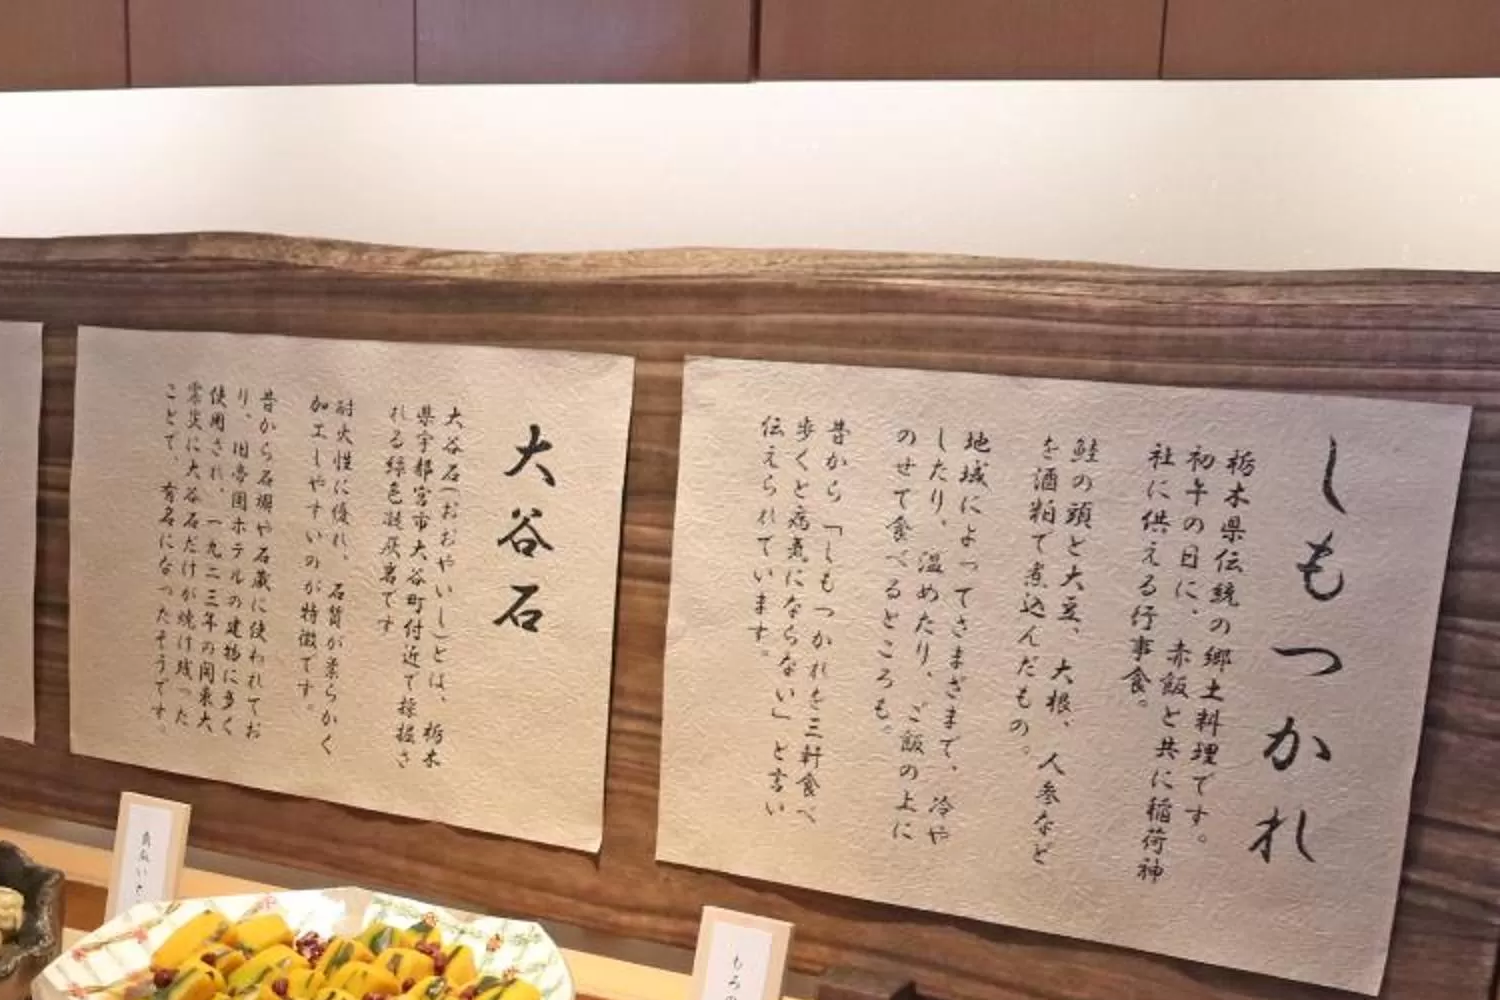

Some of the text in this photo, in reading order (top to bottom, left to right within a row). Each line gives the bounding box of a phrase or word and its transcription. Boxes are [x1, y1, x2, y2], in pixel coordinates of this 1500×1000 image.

[493, 424, 555, 632] 大谷石
[1122, 443, 1175, 707] 社に供える行事食。
[1137, 445, 1215, 883] 初午の日に、赤飯と共に稲荷神
[1248, 437, 1346, 863] しもつかれ
